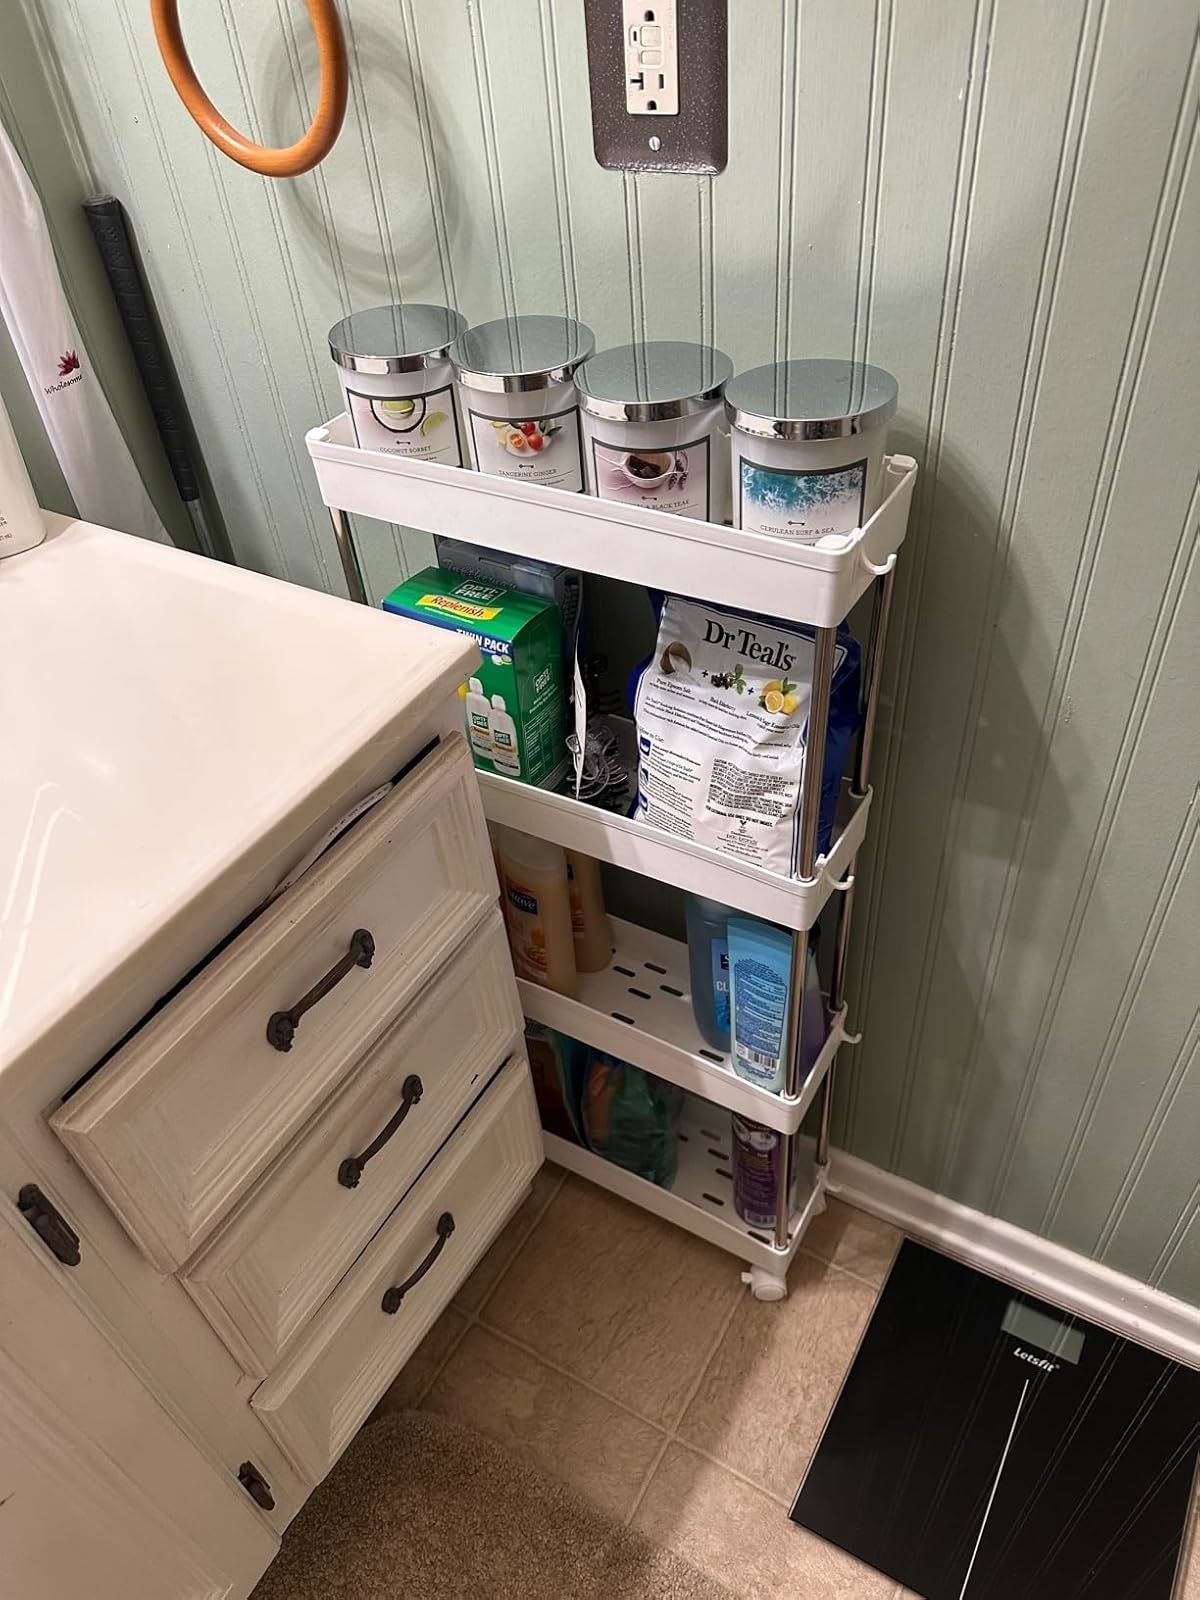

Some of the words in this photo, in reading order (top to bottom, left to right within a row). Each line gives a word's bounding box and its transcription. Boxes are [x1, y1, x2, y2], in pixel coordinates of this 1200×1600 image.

[44, 374, 83, 395] Wholesome
[409, 445, 431, 453] SORBET
[498, 470, 532, 478] TANGERINE
[533, 468, 557, 477] GINGER
[651, 502, 672, 510] BLACK
[759, 524, 795, 535] CERULEAN
[795, 528, 814, 536] SURF
[821, 526, 835, 534] SEA
[455, 589, 494, 601] FREE
[484, 637, 510, 654] PACK
[703, 618, 737, 650] Dr
[738, 628, 797, 672] Teal's
